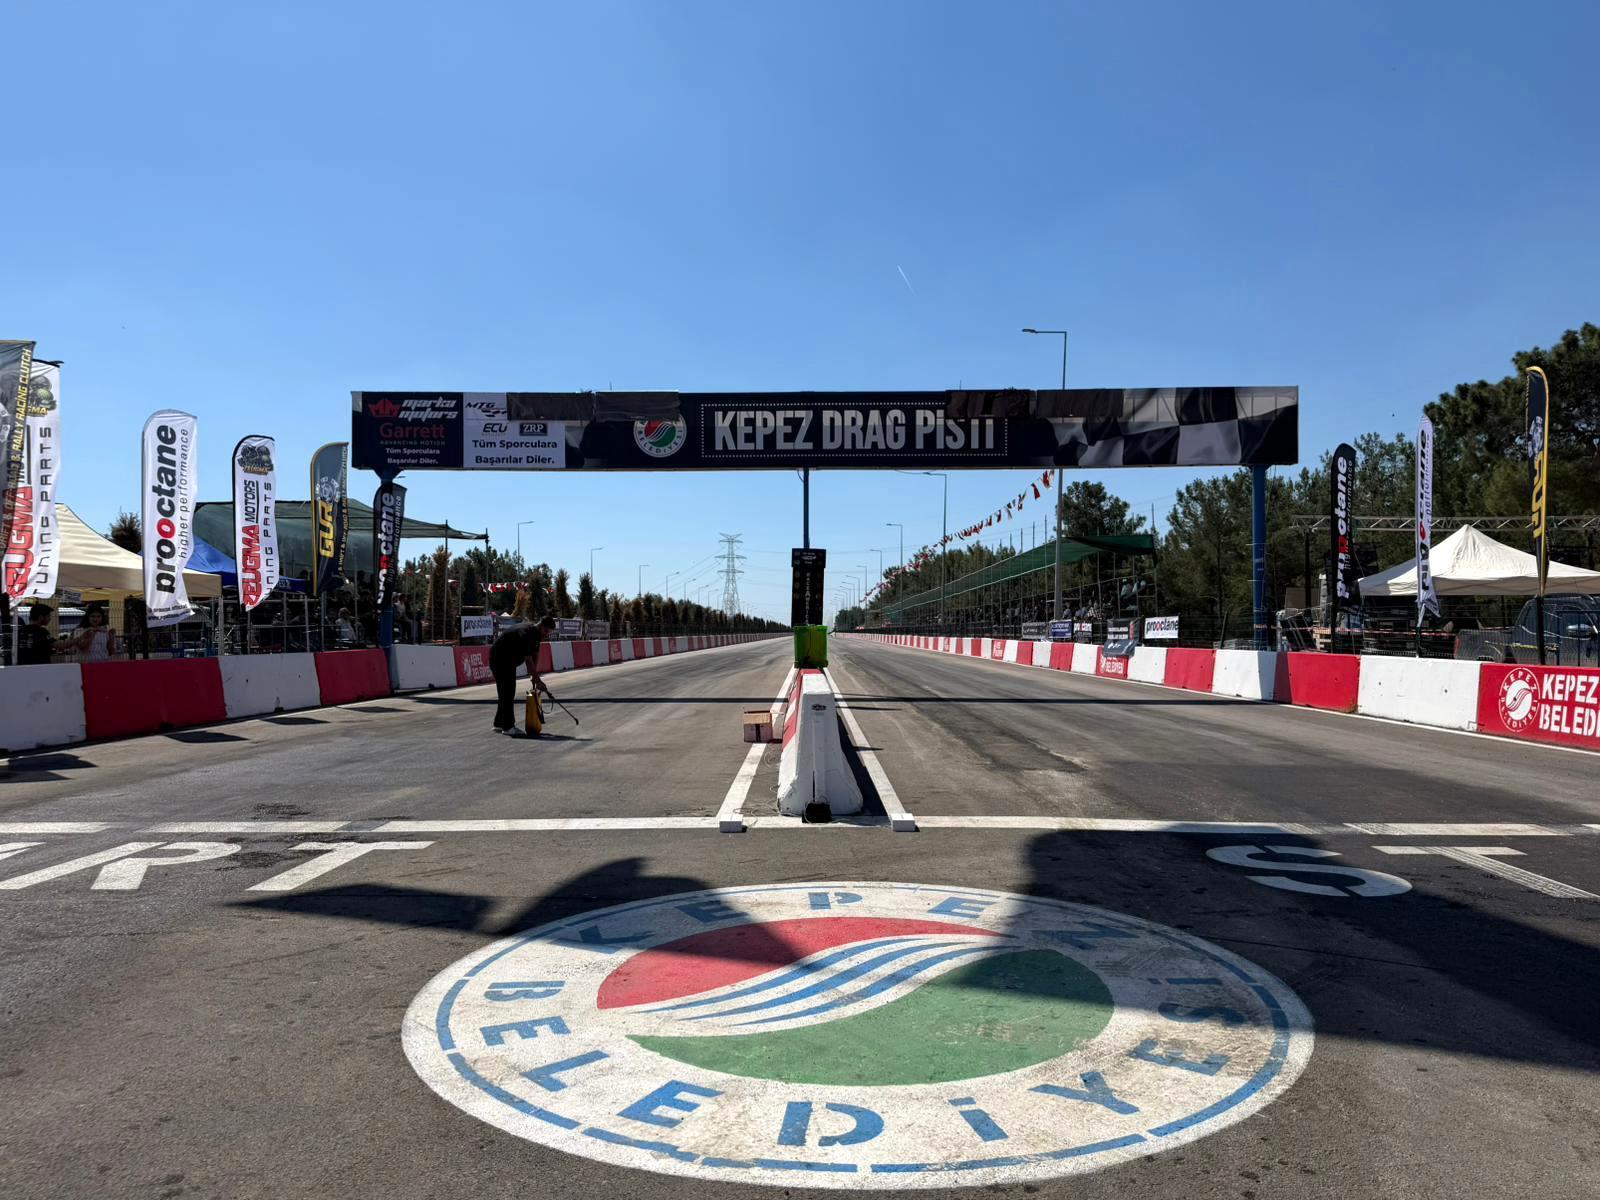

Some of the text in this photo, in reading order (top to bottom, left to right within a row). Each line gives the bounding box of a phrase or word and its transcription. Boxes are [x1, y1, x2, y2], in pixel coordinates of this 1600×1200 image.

[12, 423, 24, 452] RALLY
[18, 348, 31, 385] CLUTCH
[379, 422, 447, 439] Garrett
[472, 440, 558, 450] Tüm Sporculara
[483, 423, 508, 433] ECU
[522, 423, 544, 433] ZRP
[714, 410, 813, 451] KEPEZ
[822, 410, 906, 451] DRAG
[39, 427, 52, 502] PARTS
[475, 455, 523, 466] Başarılar
[152, 424, 177, 594] prooctane
[178, 429, 190, 559] higher performance
[244, 480, 256, 522] MOTORS
[263, 482, 272, 537] PARTS
[1503, 671, 1537, 692] KEPEZ
[1542, 673, 1600, 704] KEPEZ
[0, 841, 434, 891] RT
[551, 889, 1140, 953] KEPEZ
[480, 978, 1250, 1148] BELEDİYESİ
